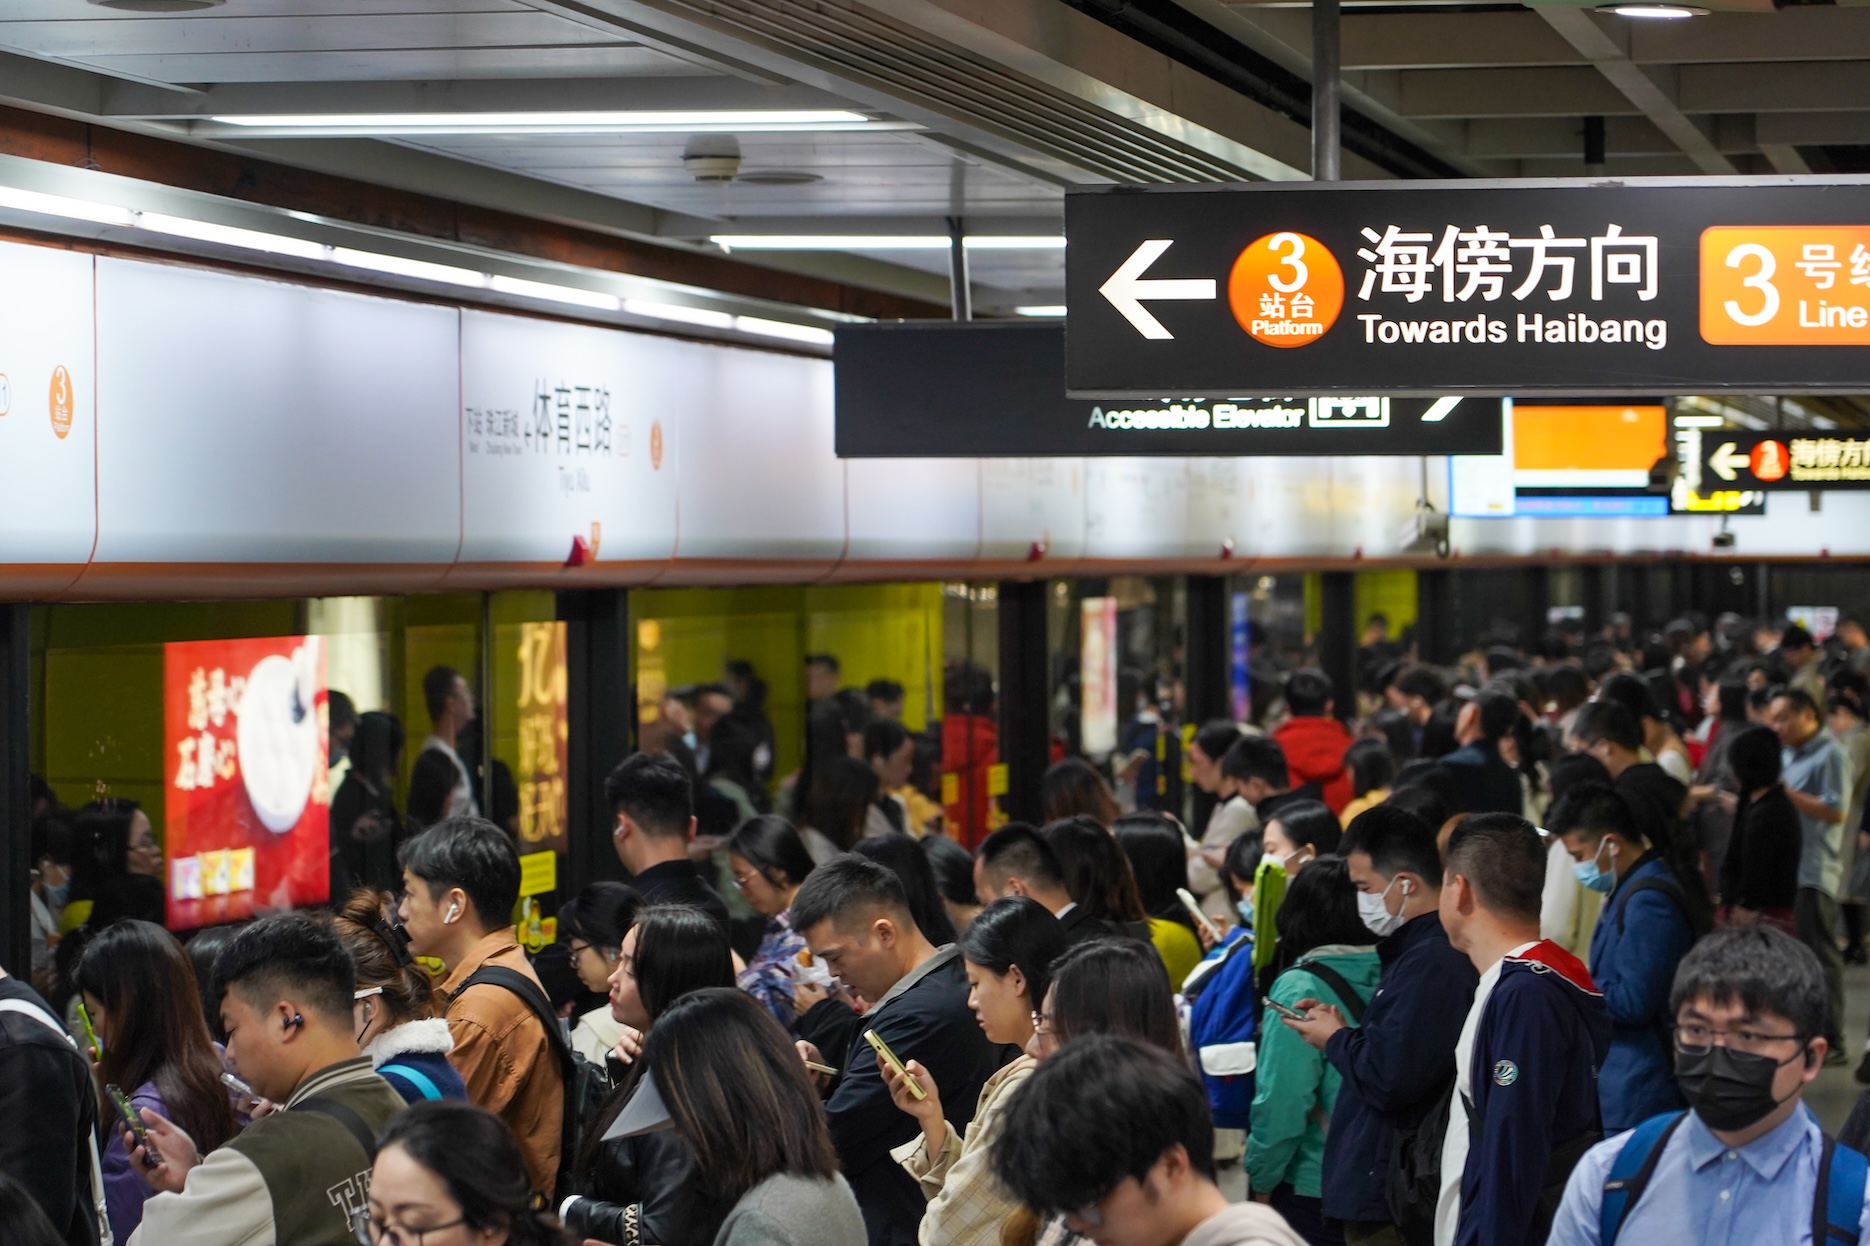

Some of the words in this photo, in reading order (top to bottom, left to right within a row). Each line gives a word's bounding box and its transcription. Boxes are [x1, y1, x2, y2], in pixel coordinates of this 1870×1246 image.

[1266, 232, 1309, 293] 3
[1356, 224, 1660, 303] 海傍方向
[1723, 243, 1780, 326] 3
[1259, 292, 1315, 319] 站台
[1799, 299, 1869, 328] Line
[1251, 318, 1323, 336] Platform
[1357, 314, 1508, 344] Towards
[1517, 314, 1668, 350] Haibang
[55, 366, 67, 405] 3
[533, 377, 613, 455] 体育西路
[1087, 403, 1210, 429] Accessible
[1211, 403, 1306, 429] Elevator
